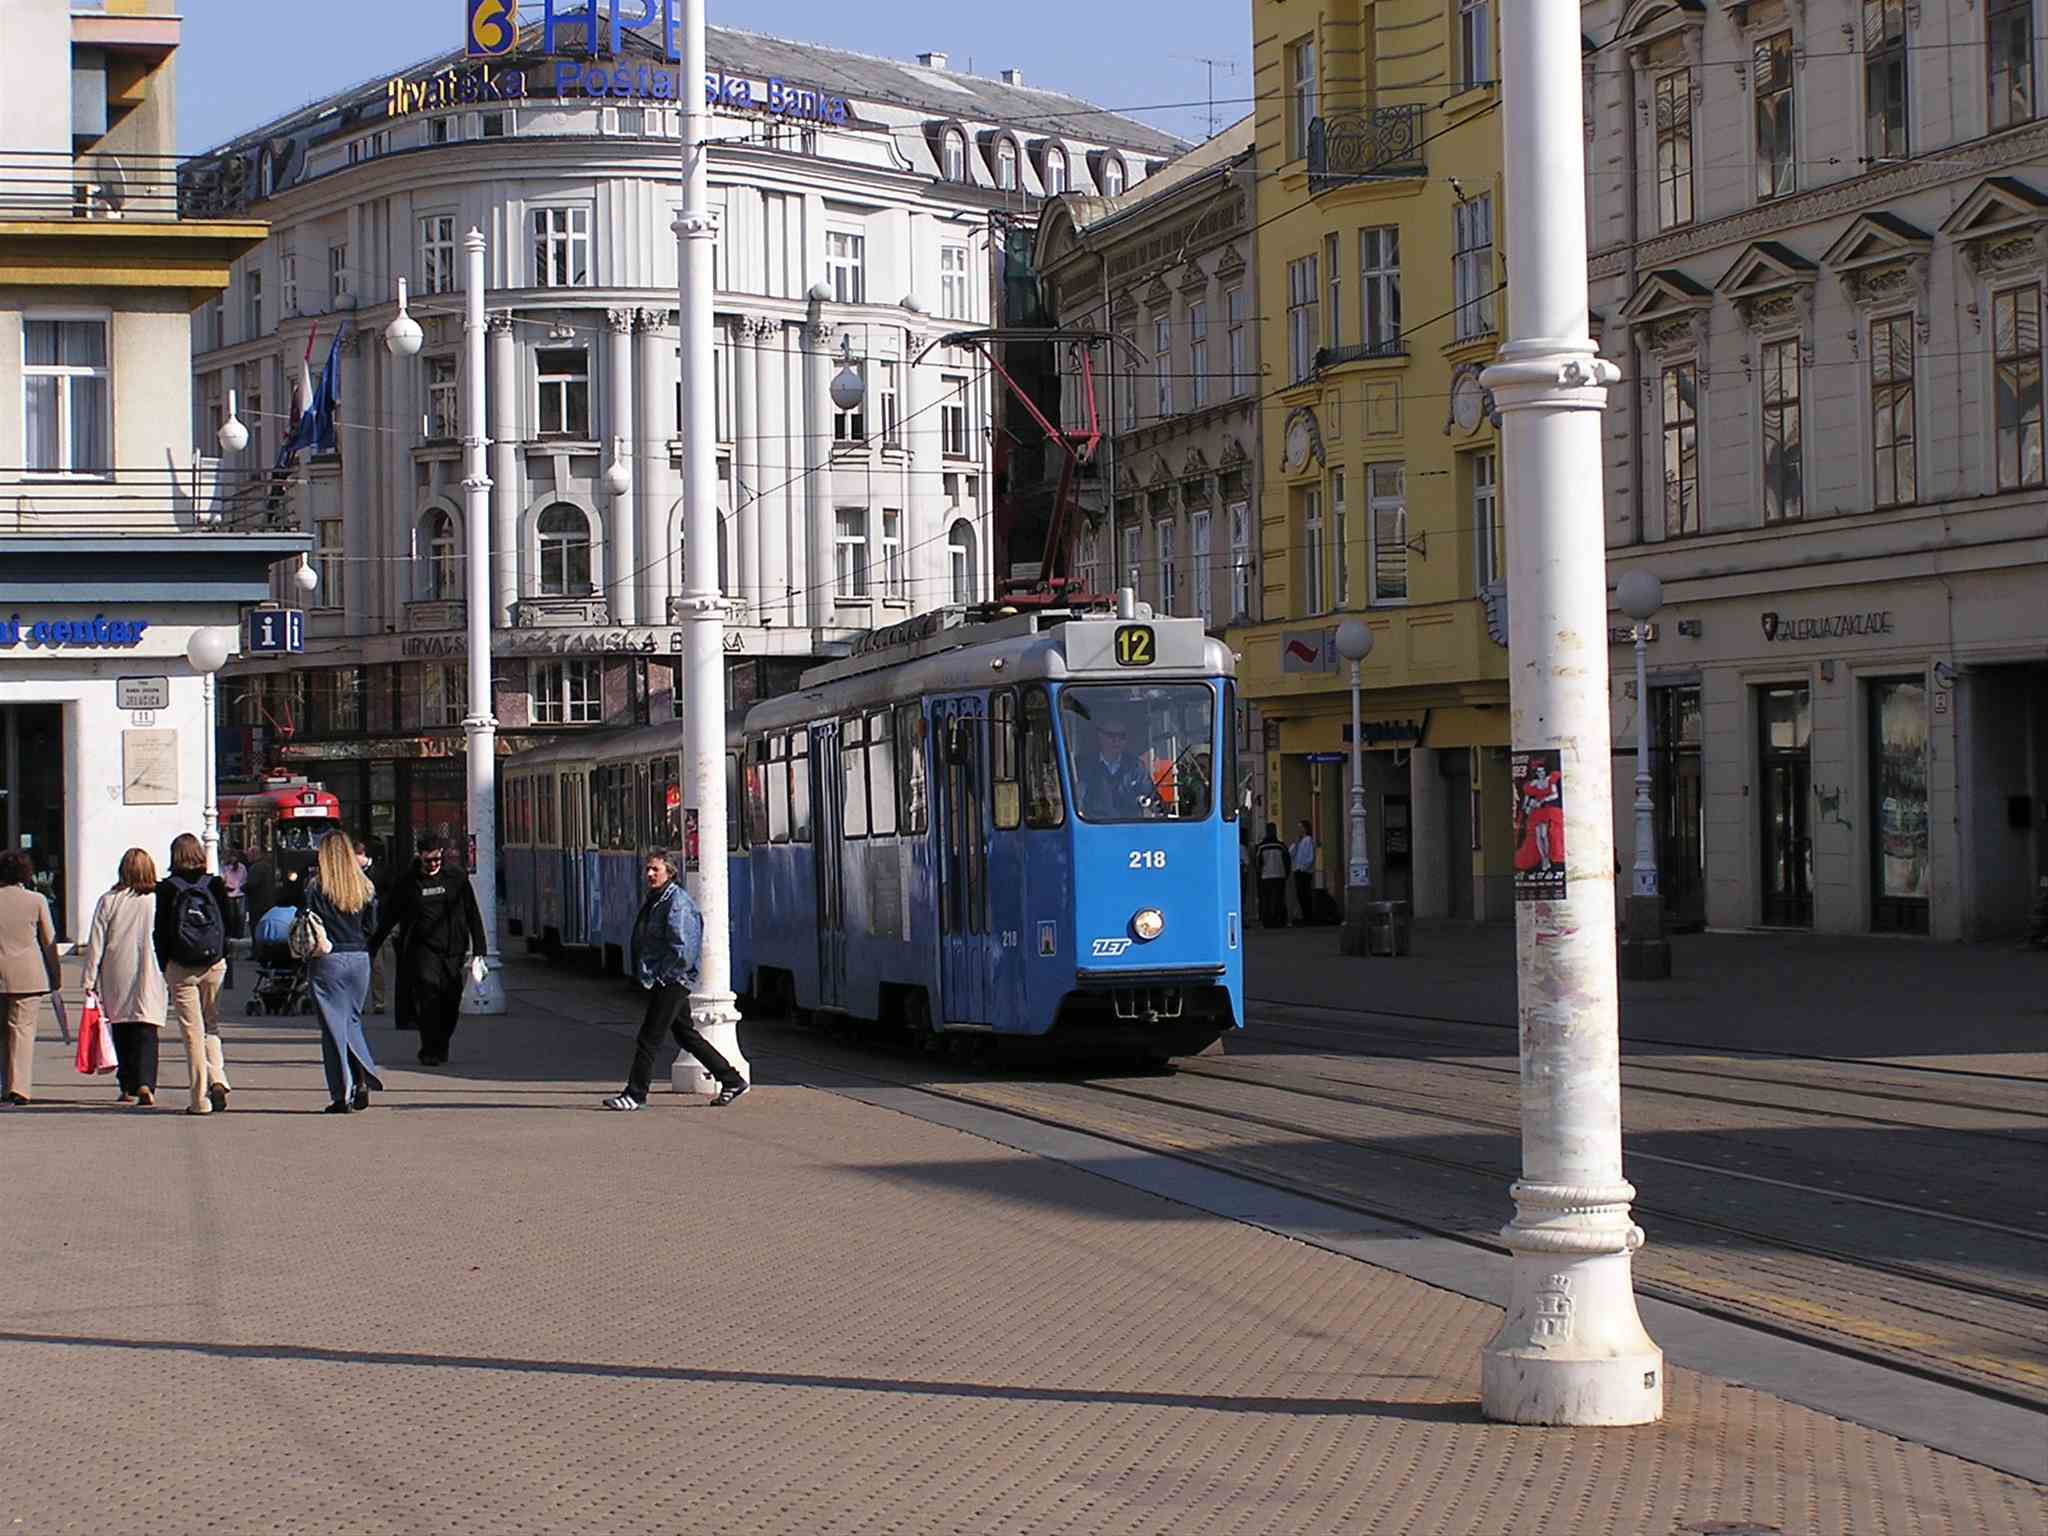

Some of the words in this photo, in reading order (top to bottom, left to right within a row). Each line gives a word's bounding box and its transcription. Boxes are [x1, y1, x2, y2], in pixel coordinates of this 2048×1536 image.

[386, 64, 528, 117] Hrvatska
[556, 60, 752, 108] Poštaska
[768, 76, 848, 124] Banka
[28, 614, 147, 645] centar
[1119, 629, 1151, 661] 12
[1128, 851, 1167, 869] 218
[1092, 938, 1132, 956] ZET
